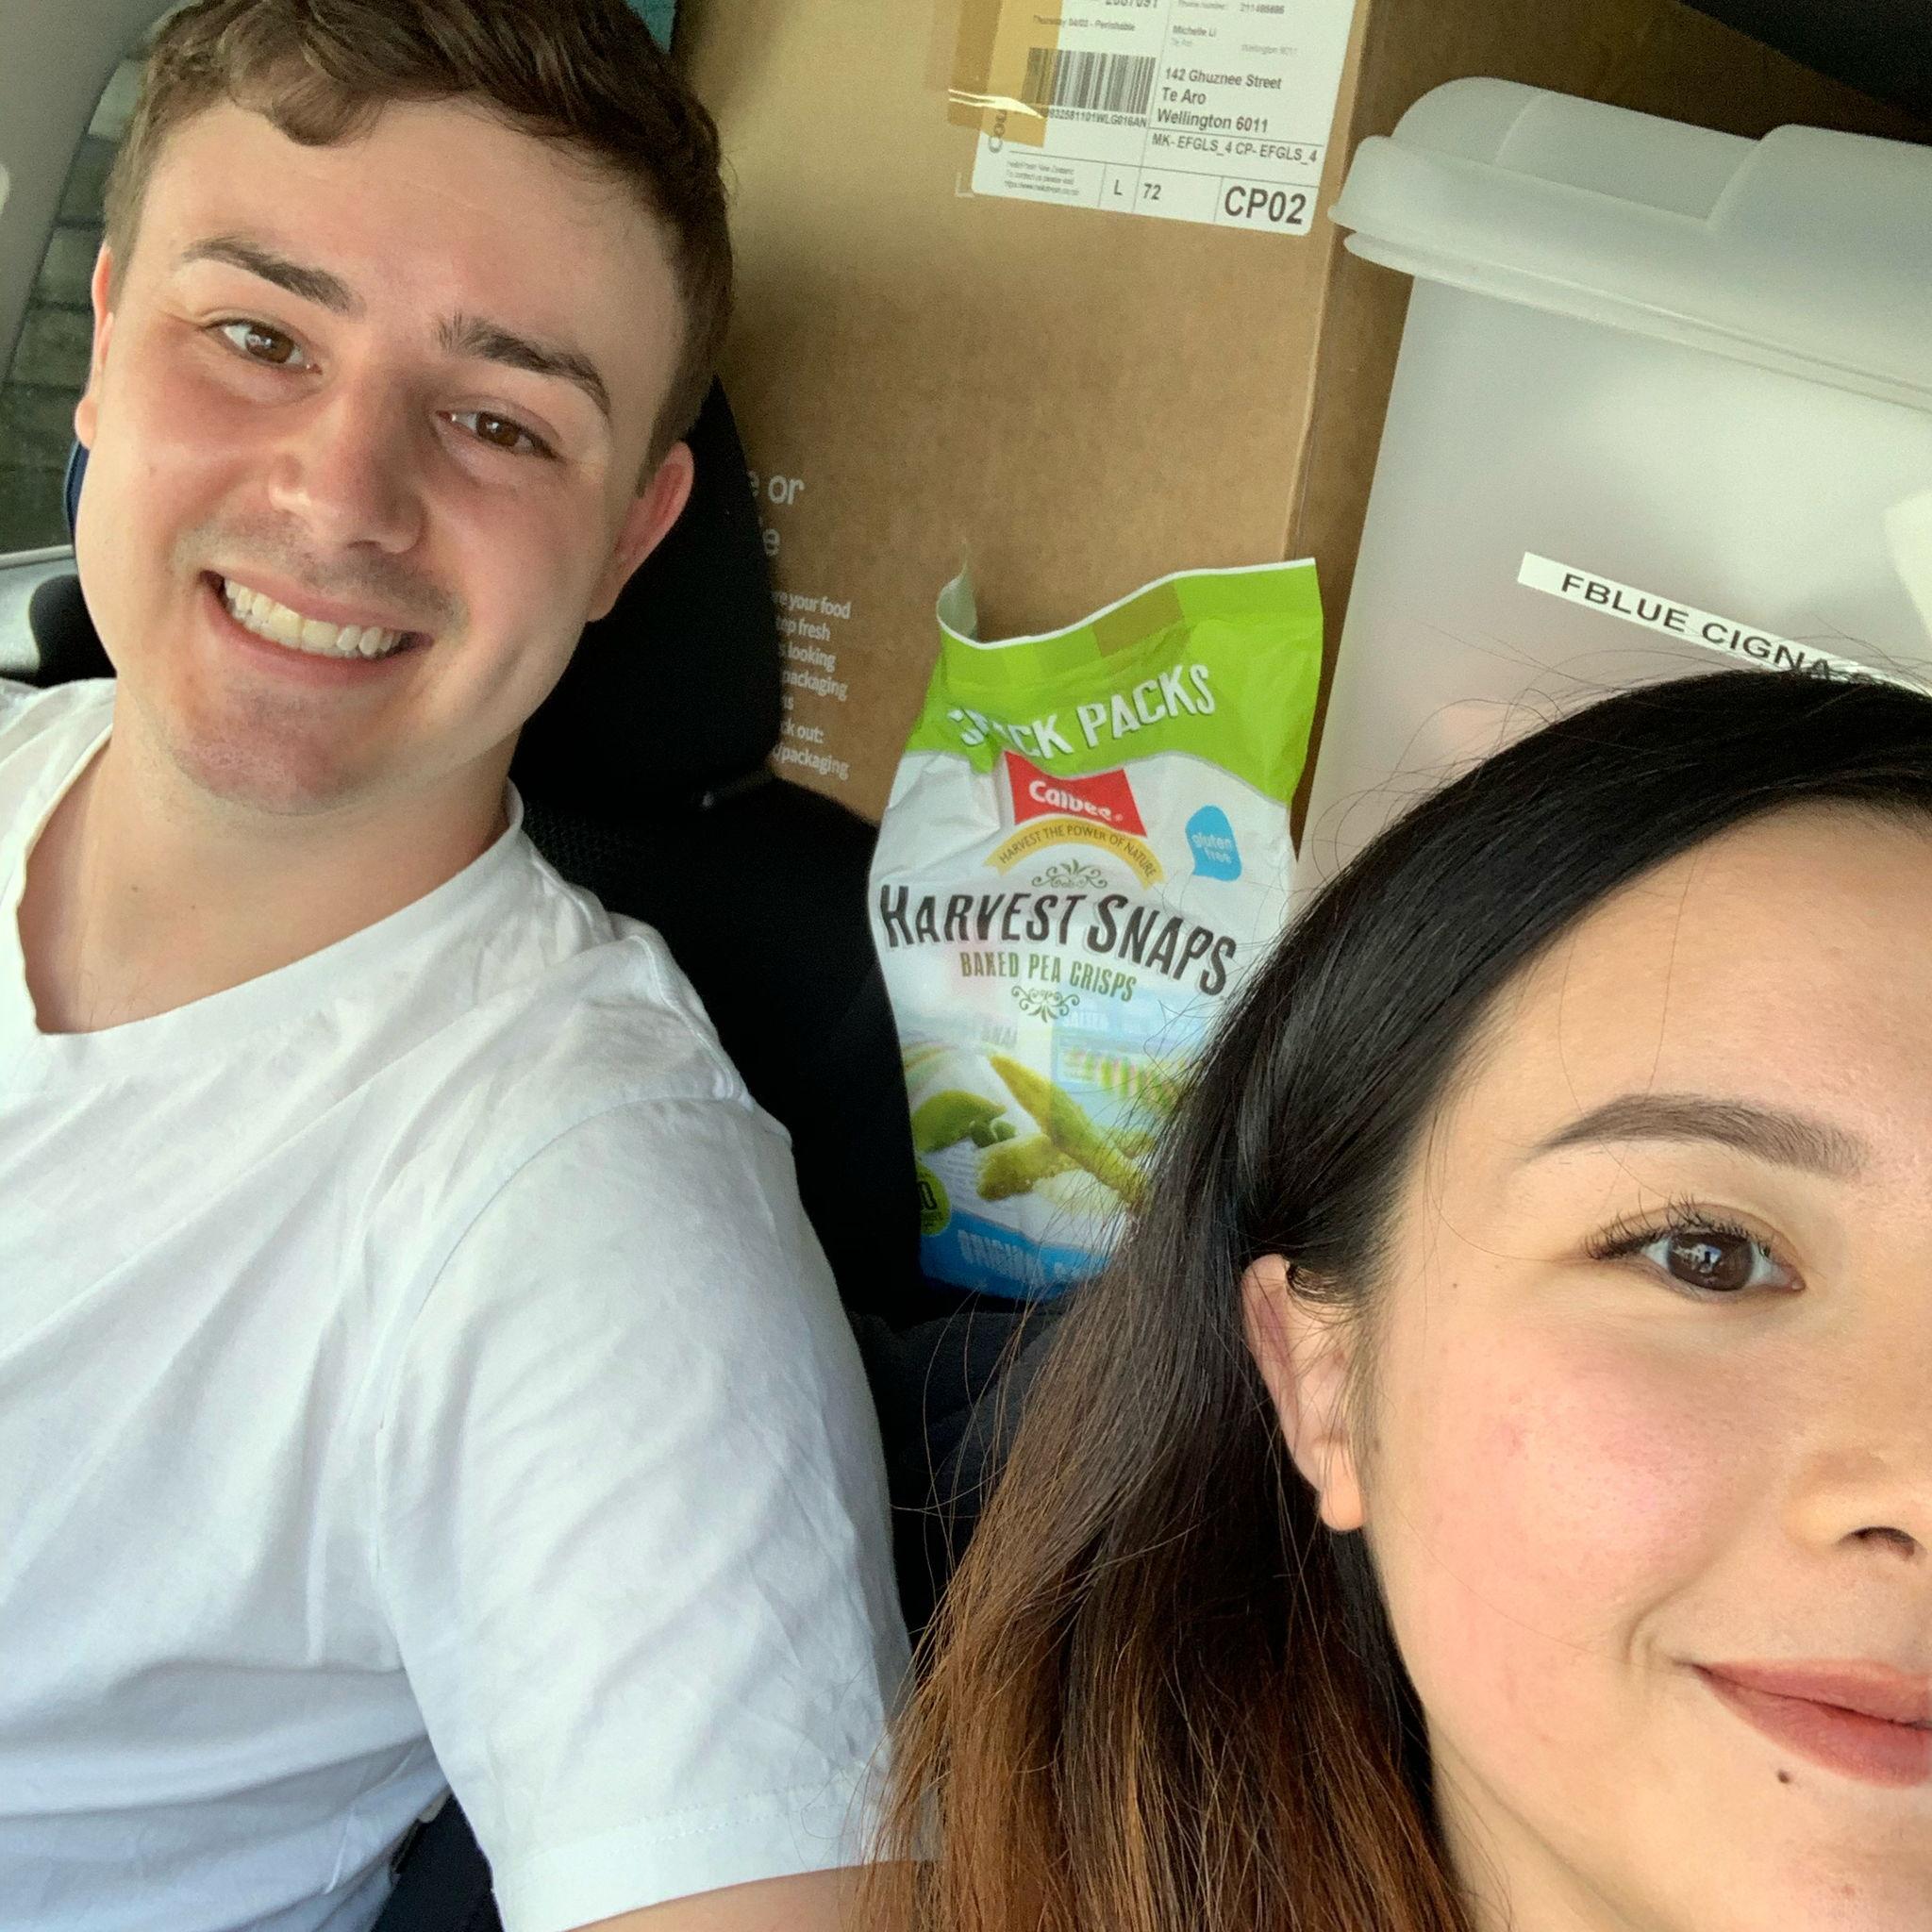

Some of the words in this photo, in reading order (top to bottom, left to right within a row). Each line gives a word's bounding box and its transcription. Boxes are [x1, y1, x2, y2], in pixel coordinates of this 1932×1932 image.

[1173, 25, 1208, 37] Michelle
[1166, 67, 1187, 82] 142
[1189, 69, 1242, 87] Ghuznee
[1246, 74, 1282, 91] Street
[1162, 87, 1178, 102] Te
[1181, 89, 1207, 105] Aro
[1158, 108, 1232, 130] Wellington
[1236, 115, 1269, 134] 6011
[1113, 178, 1123, 196] L
[1142, 182, 1162, 201] 72
[1224, 184, 1307, 225] CP02
[768, 475, 805, 506] or
[790, 593, 819, 613] your
[820, 595, 852, 620] food
[1560, 572, 1690, 633] FBLUE
[798, 618, 831, 642] fresh
[787, 641, 837, 674] looking
[1077, 663, 1217, 749] PACKS
[1028, 779, 1112, 823] Calbee
[999, 831, 1042, 864] HARVEST
[1042, 824, 1064, 839] THE
[1066, 824, 1107, 841] POWER
[1108, 834, 1125, 847] OF
[1124, 841, 1158, 878] NATURE
[1191, 832, 1232, 850] gluten
[879, 884, 1085, 949] HARVEST
[1085, 893, 1238, 997] SNAPS
[959, 951, 1019, 979] BAKED
[1027, 954, 1061, 983] PEA
[1069, 960, 1138, 1003] CRISPS
